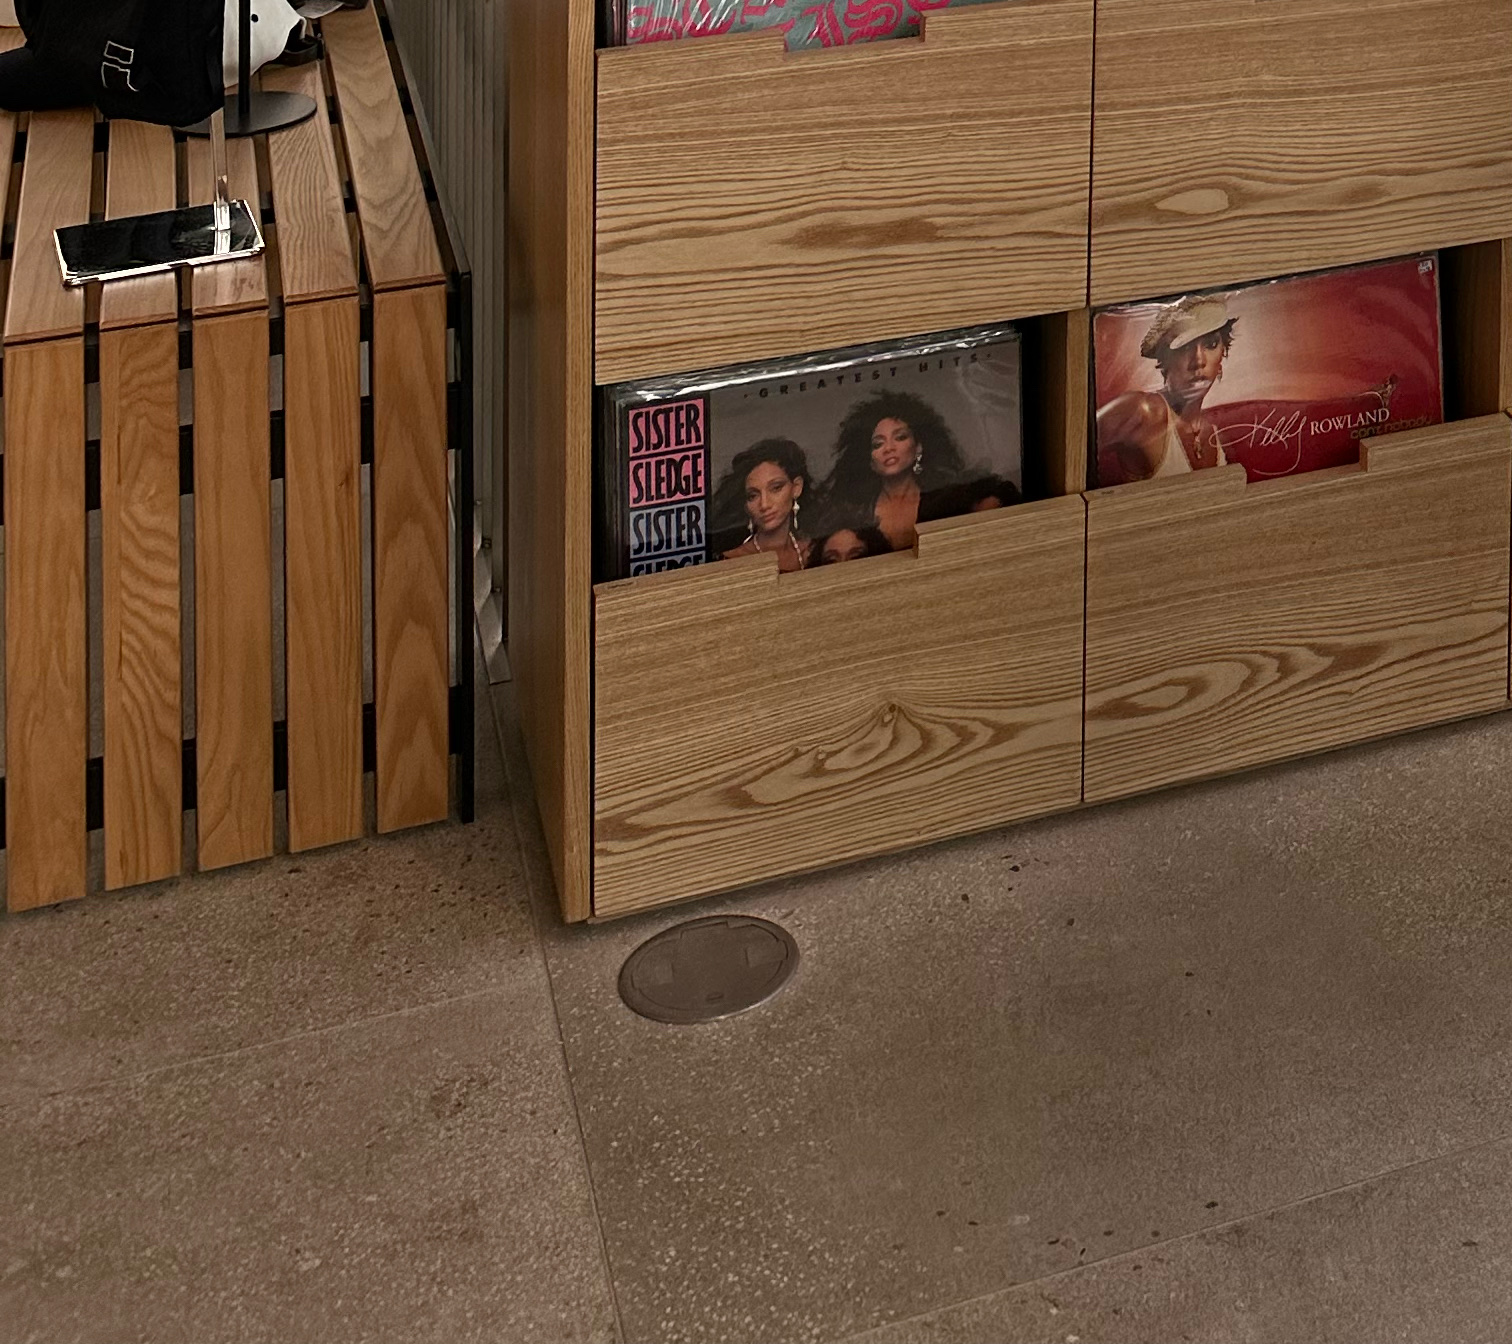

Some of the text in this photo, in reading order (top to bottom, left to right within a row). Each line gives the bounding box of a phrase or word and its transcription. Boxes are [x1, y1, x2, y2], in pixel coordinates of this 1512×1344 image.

[759, 353, 977, 398] GREATEST HITS
[632, 402, 702, 454] SISTER
[1310, 408, 1390, 436] ROWLAND
[632, 453, 702, 505] SLEDGE
[632, 504, 703, 556] SISTER
